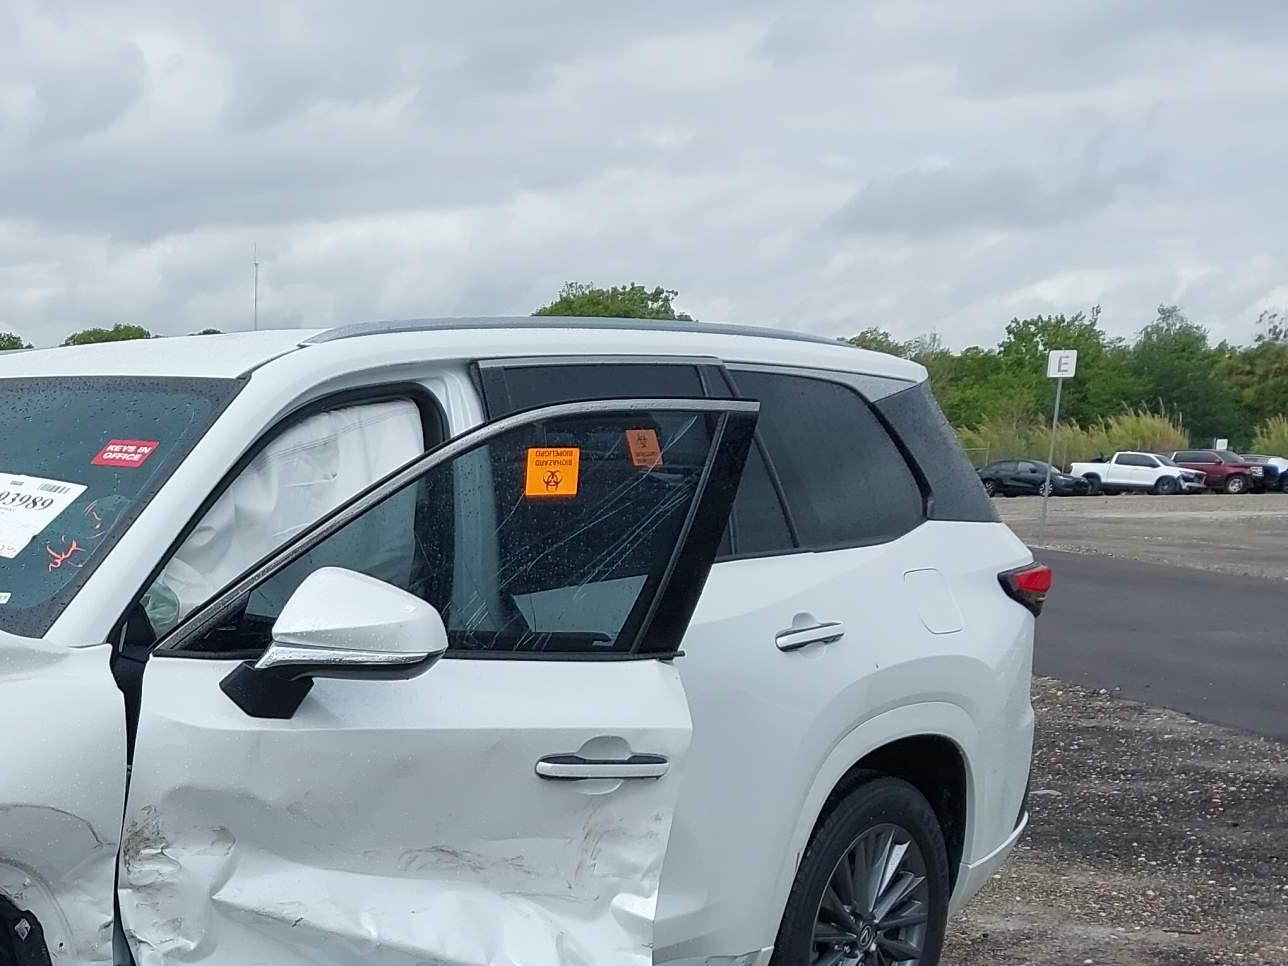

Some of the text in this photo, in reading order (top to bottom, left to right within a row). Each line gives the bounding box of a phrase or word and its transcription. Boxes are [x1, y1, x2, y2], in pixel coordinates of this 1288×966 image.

[1057, 355, 1070, 372] E
[105, 444, 152, 454] KEYS IN
[102, 452, 143, 461] OFFICE
[535, 459, 573, 467] BIOHAZARD
